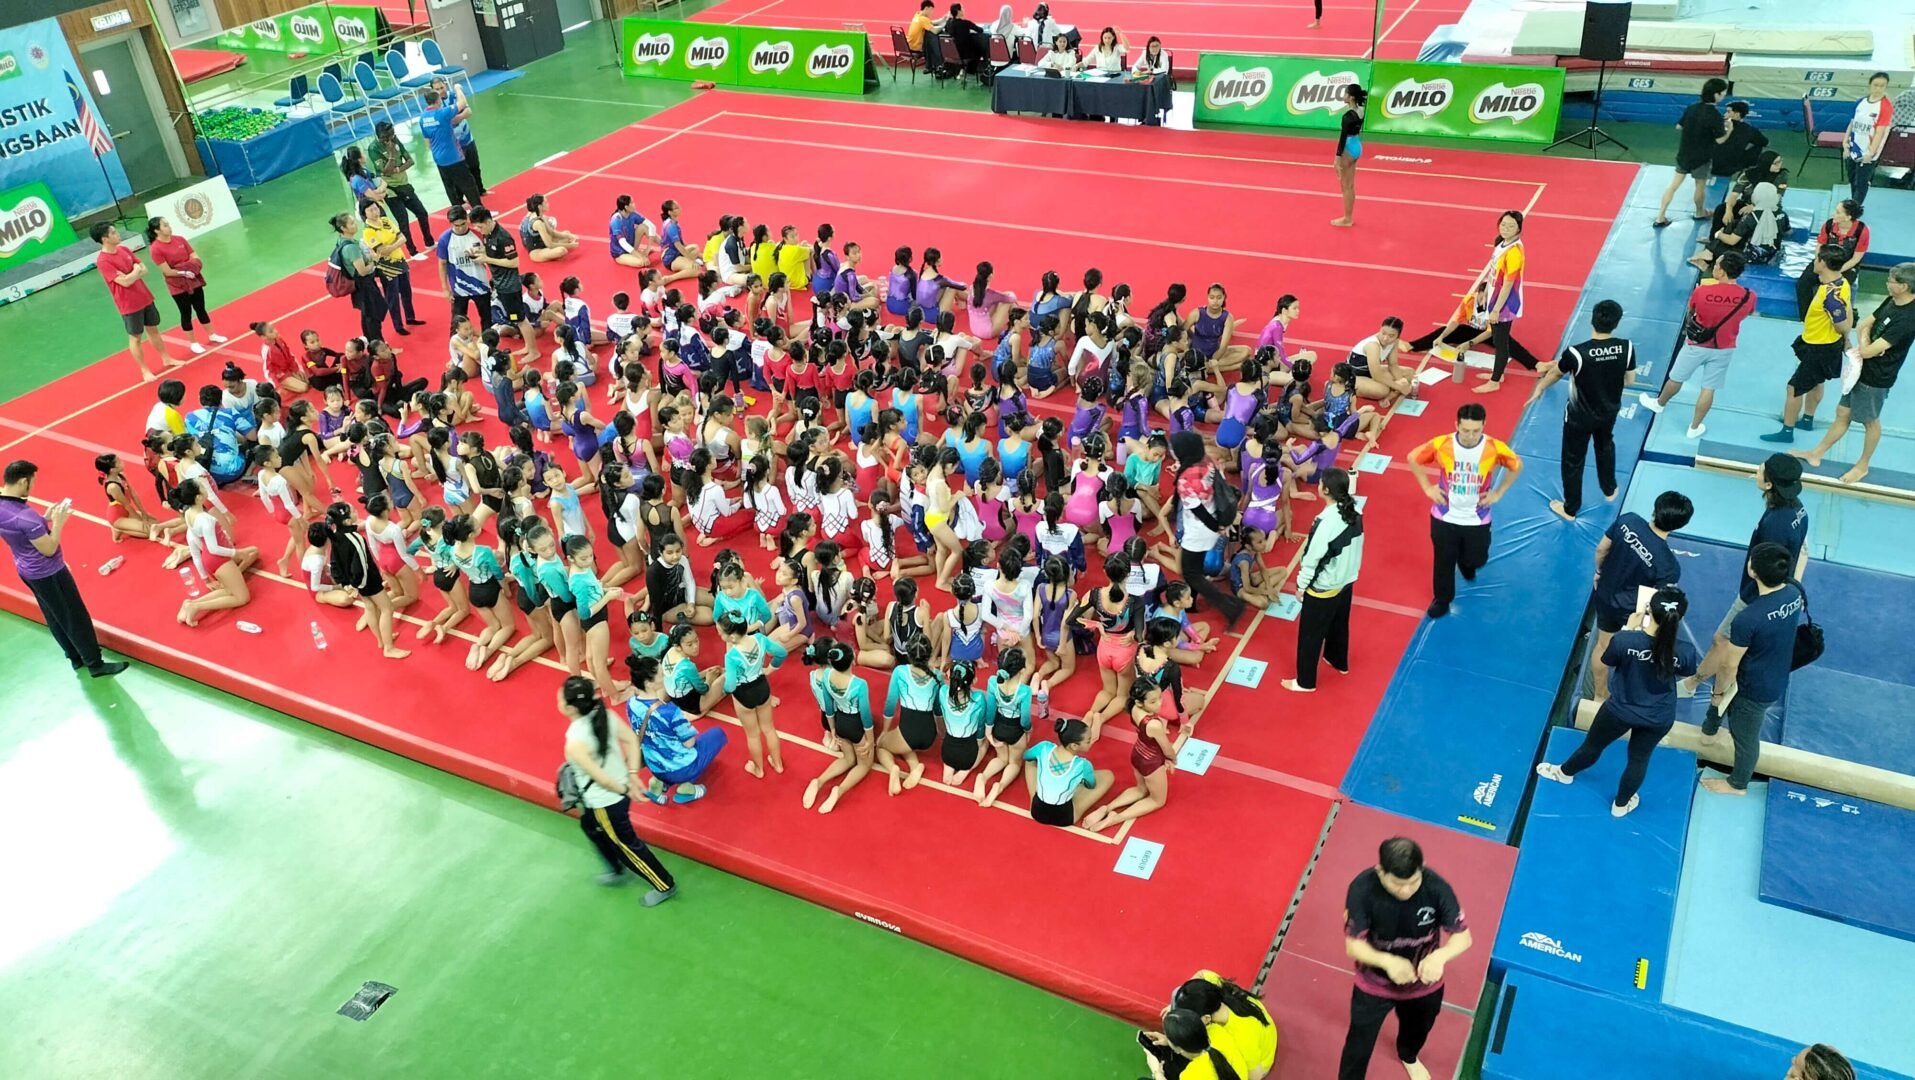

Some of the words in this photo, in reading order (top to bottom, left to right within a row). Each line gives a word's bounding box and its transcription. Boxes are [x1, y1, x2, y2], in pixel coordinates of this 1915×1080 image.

[638, 43, 670, 56] MILO
[691, 47, 725, 61] MILO
[754, 51, 790, 66] MILO
[812, 54, 850, 70] MILO
[1632, 79, 1650, 88] GES
[1809, 72, 1829, 81] GES
[1213, 79, 1266, 99] MILO
[1813, 88, 1833, 97] GES
[1391, 90, 1446, 108] MILO
[1479, 95, 1537, 114] MILO
[0, 209, 47, 248] MILO
[9, 285, 21, 300] 3
[1705, 294, 1746, 305] COAC
[1588, 344, 1623, 357] COACH
[1482, 773, 1503, 807] AMERICAN
[1137, 850, 1152, 871] GROUP
[1518, 937, 1582, 963] AMERICAN
